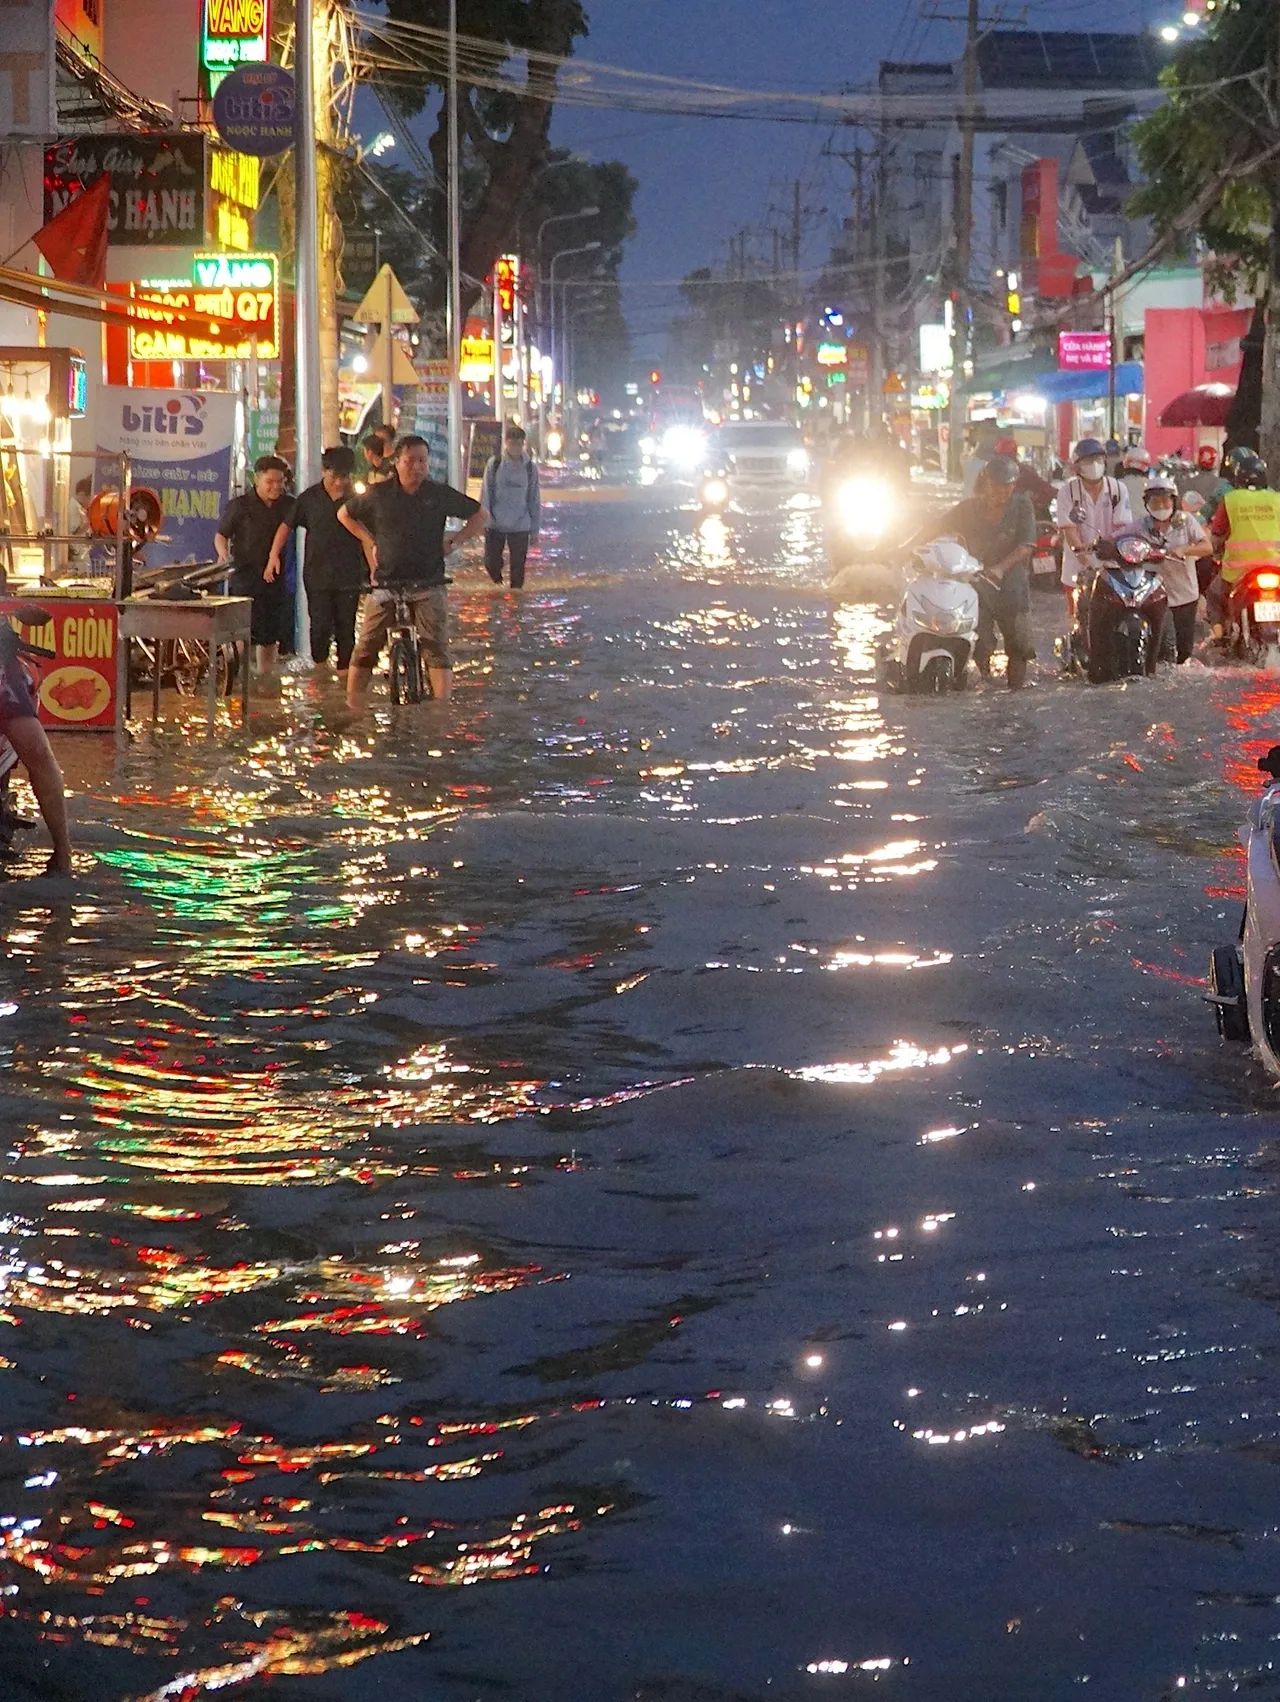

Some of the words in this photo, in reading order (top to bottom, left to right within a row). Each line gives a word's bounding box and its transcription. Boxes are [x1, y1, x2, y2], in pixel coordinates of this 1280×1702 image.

[237, 292, 273, 321] Q7
[122, 404, 204, 435] biti's
[161, 487, 221, 526] HẠNH
[62, 607, 113, 659] GIÒN
